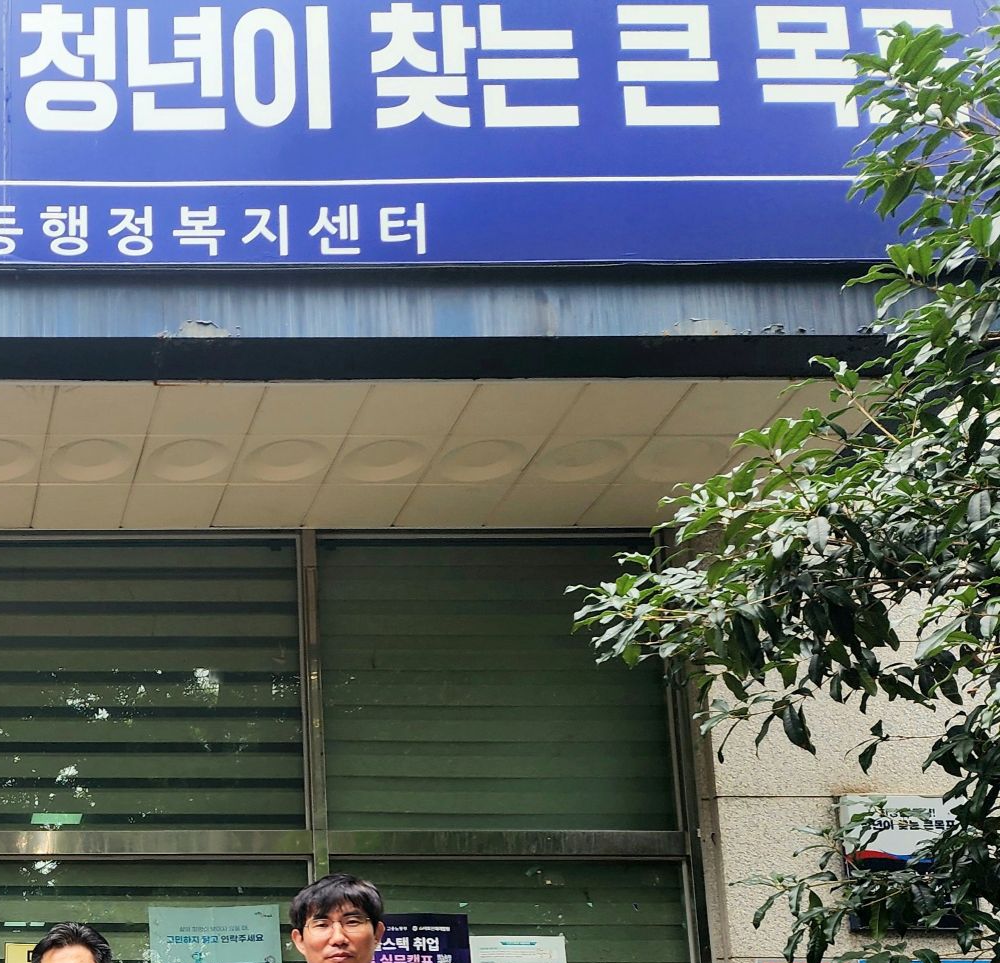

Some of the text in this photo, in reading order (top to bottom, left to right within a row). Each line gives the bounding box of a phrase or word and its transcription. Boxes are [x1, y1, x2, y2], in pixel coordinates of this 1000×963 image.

[21, 3, 333, 131] 청년이
[371, 4, 580, 129] 찾는
[617, 8, 721, 126] 큰
[221, 933, 264, 944] 연락주세요
[413, 937, 440, 951] 취업
